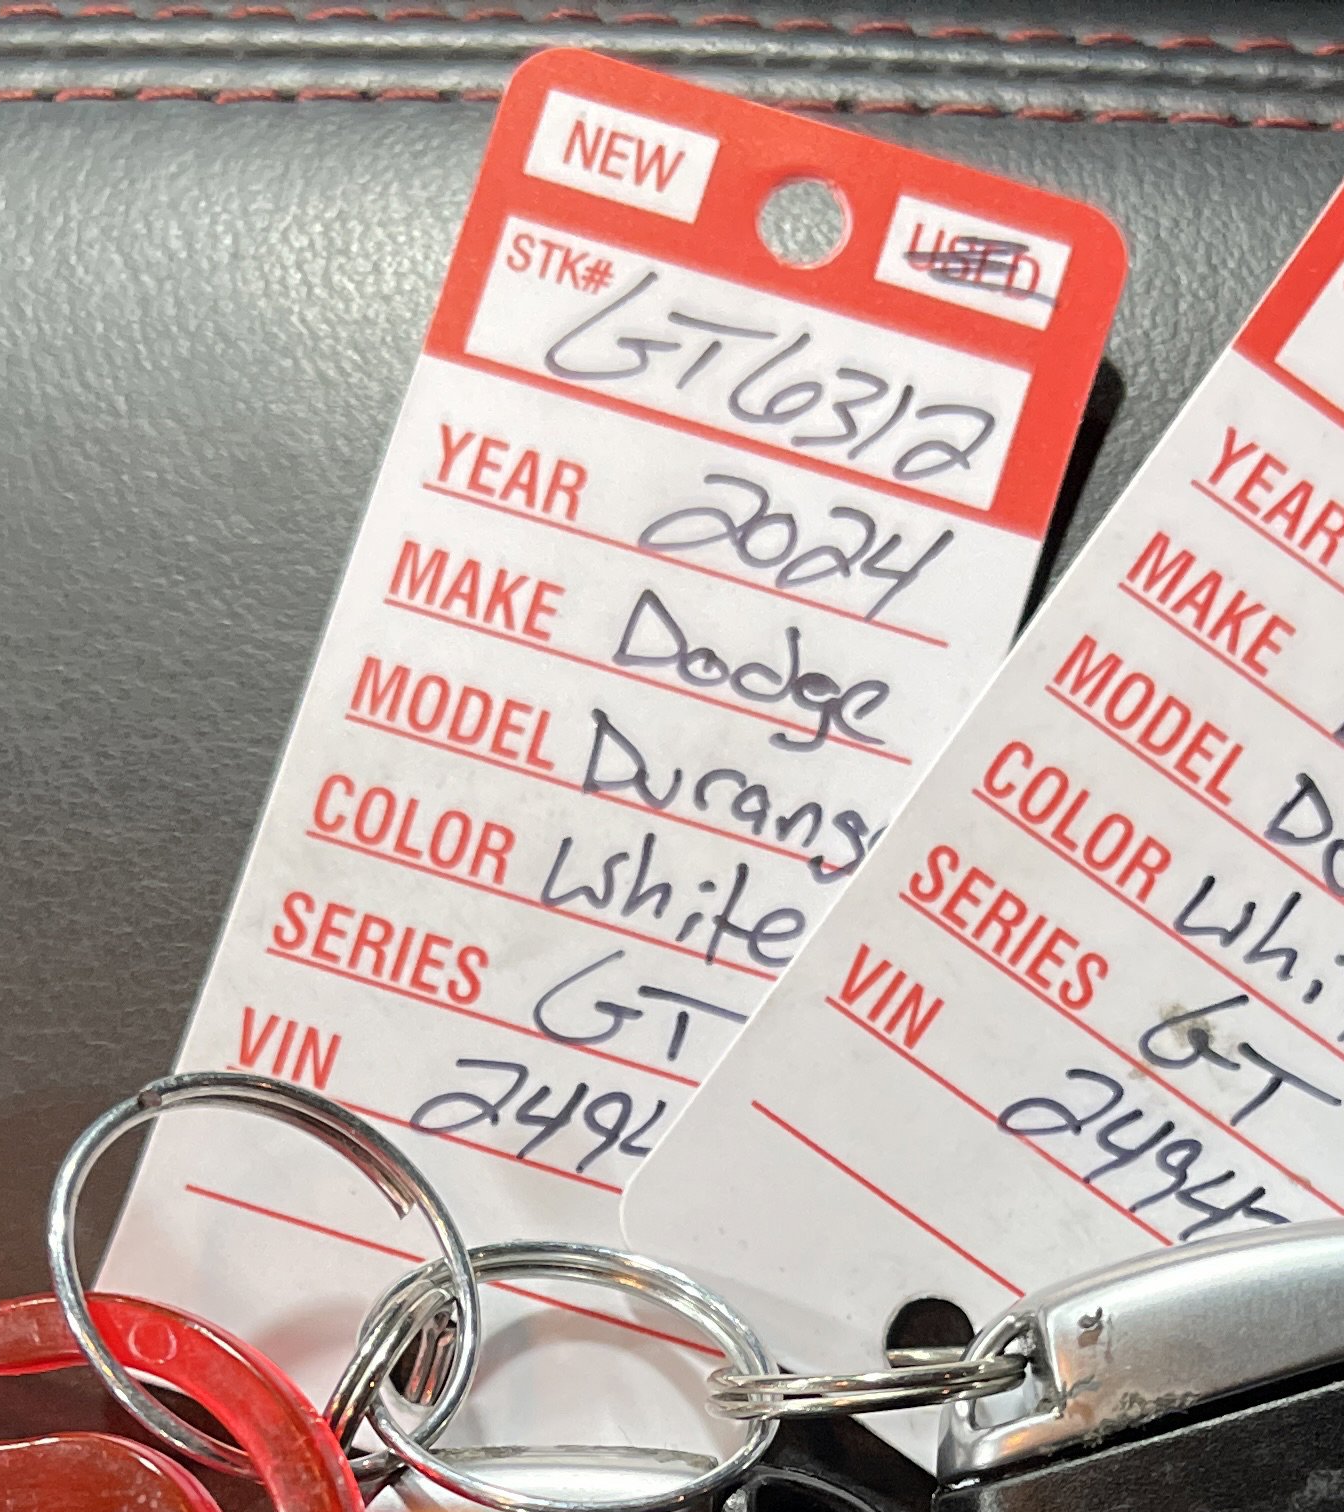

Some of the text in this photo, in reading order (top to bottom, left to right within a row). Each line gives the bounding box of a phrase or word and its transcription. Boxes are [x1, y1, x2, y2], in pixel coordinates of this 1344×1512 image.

[562, 117, 686, 194] NEW
[506, 233, 614, 295] STK#
[545, 272, 995, 479] GT6312
[437, 424, 589, 521] YEAR
[387, 539, 565, 641] MAKE
[638, 474, 953, 621] 2024
[1124, 532, 1295, 679] MAKE
[350, 655, 556, 770] MODEL
[614, 590, 889, 751] Dodge
[1053, 634, 1245, 804] MODEL
[312, 774, 516, 884] COLOR
[583, 708, 888, 884] Durang
[982, 739, 1172, 904] COLOR
[272, 891, 491, 1004] SERIES
[541, 833, 807, 966] White
[909, 844, 1109, 1011] SERIES
[237, 1007, 342, 1089] VIN
[534, 951, 749, 1061] GT
[837, 945, 944, 1050] VIN
[1139, 996, 1341, 1126] GT
[997, 1068, 1292, 1241] 2494
